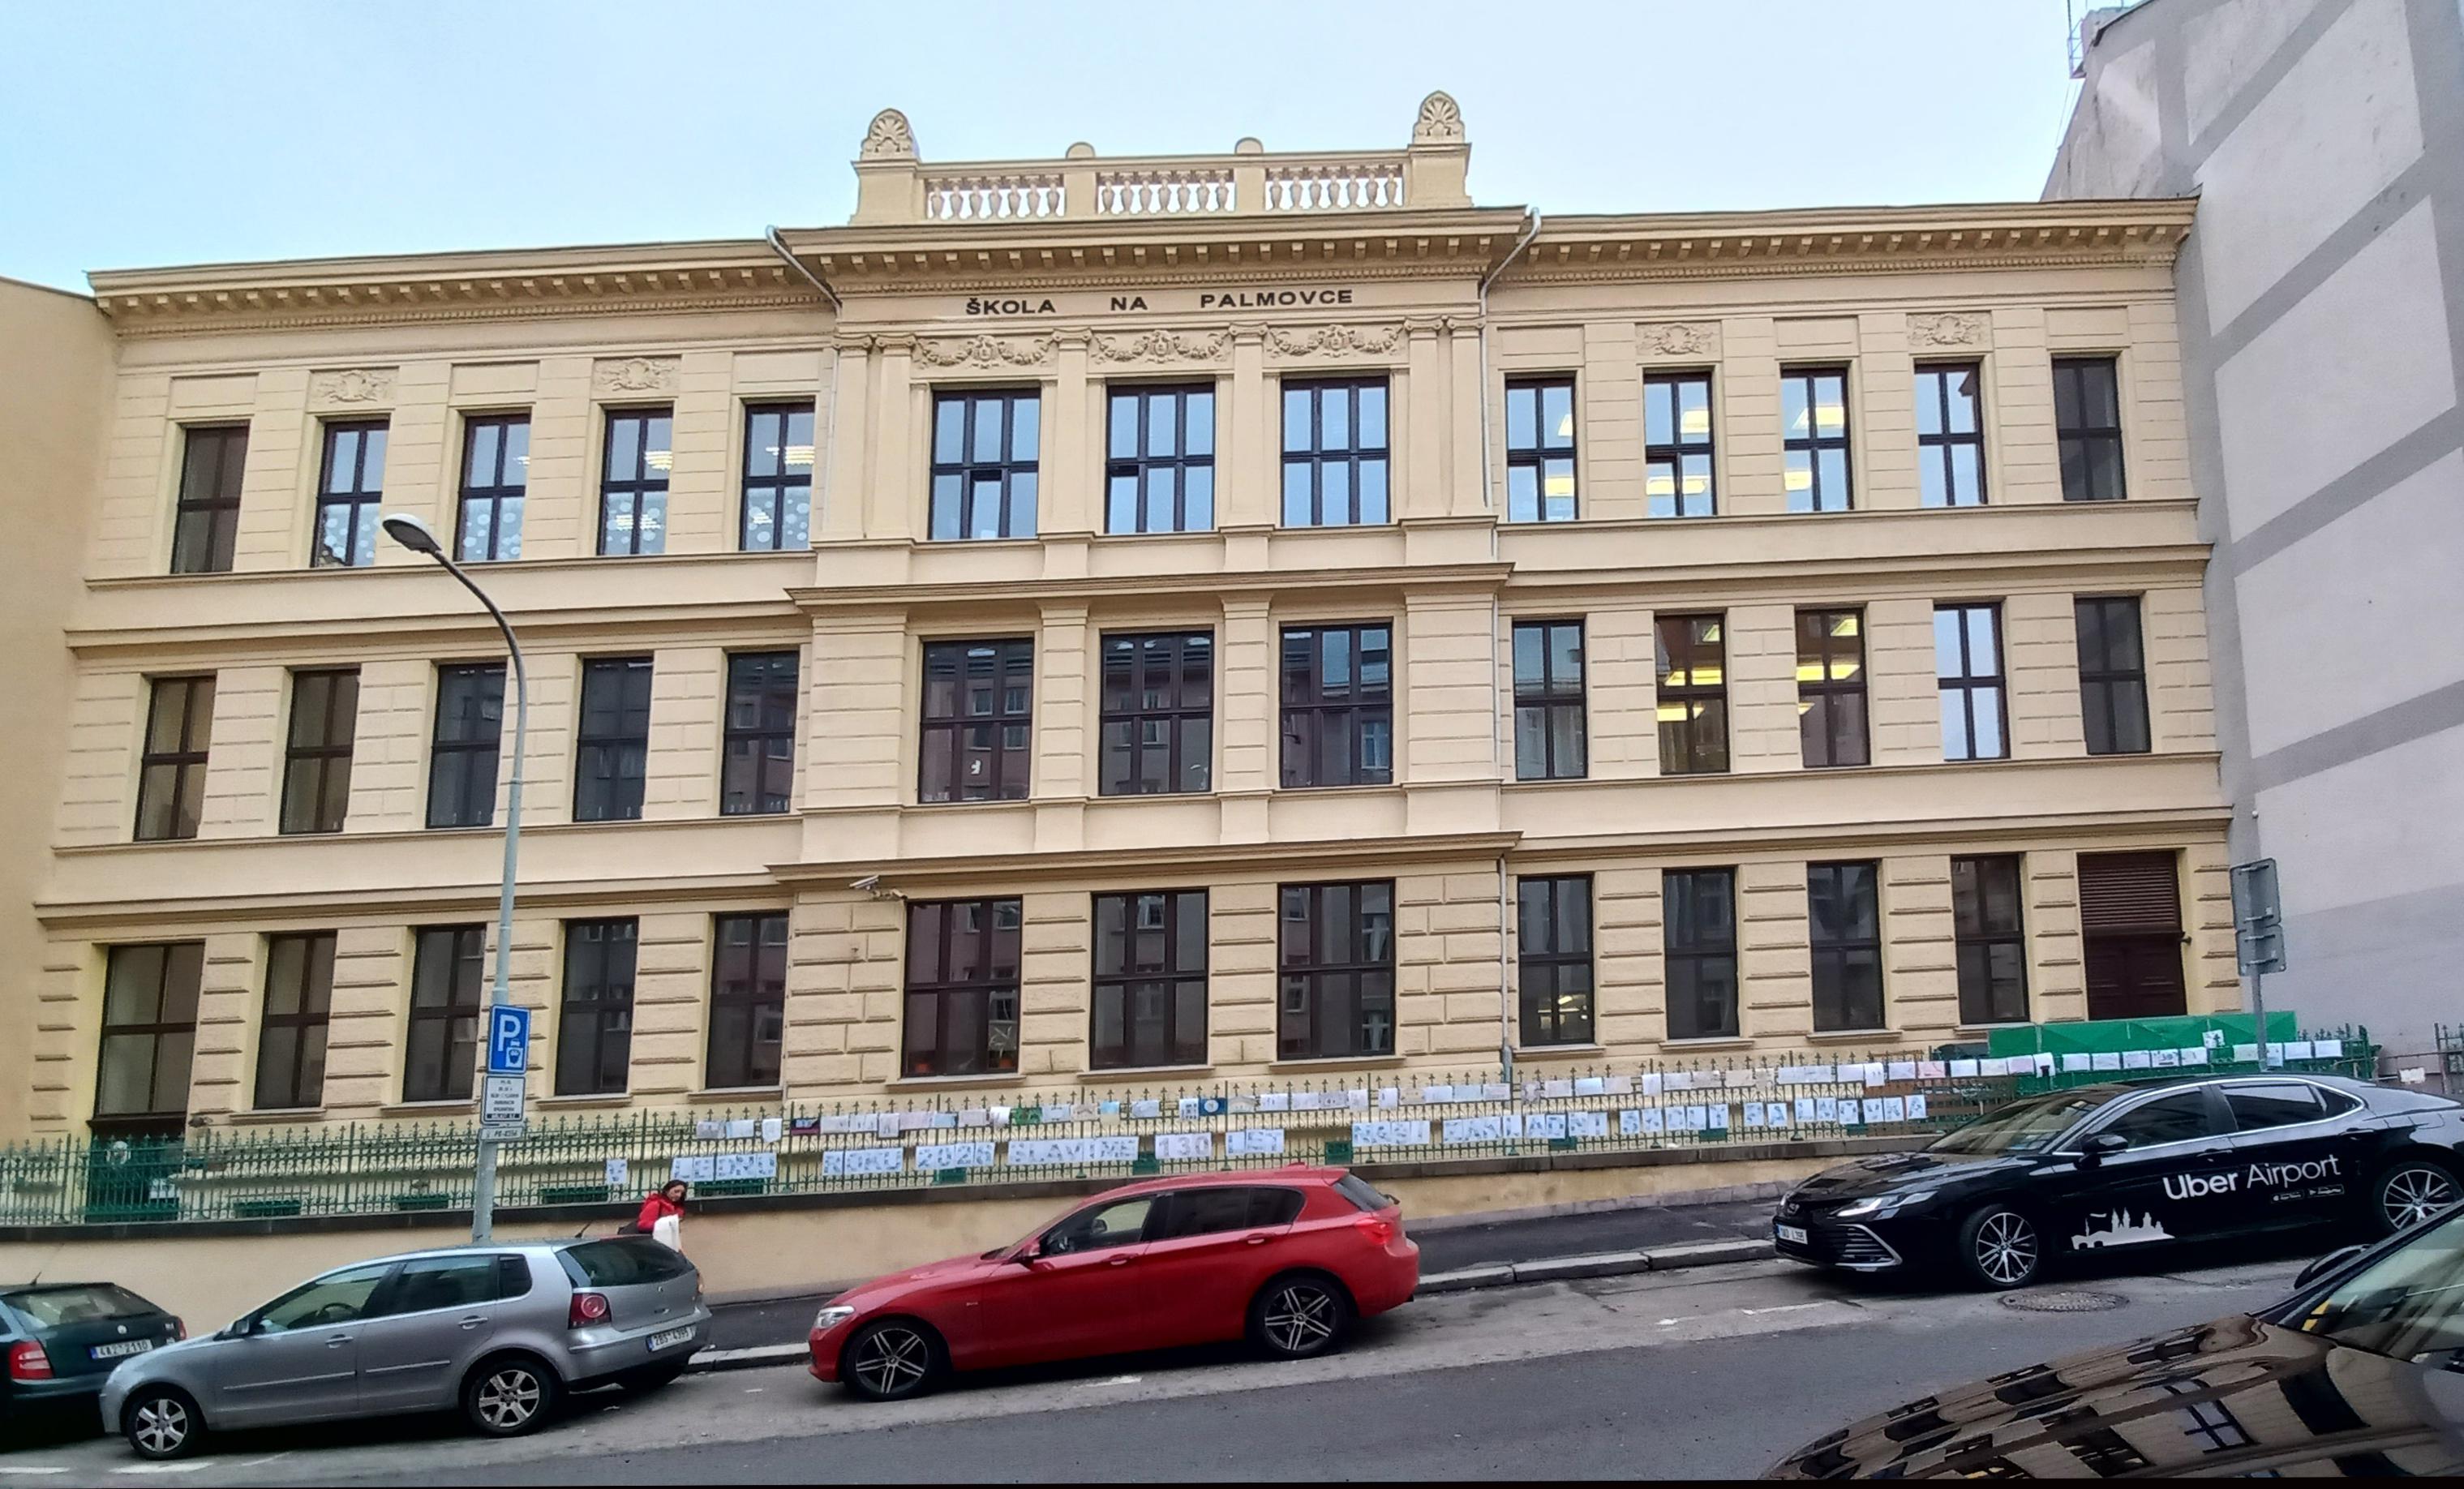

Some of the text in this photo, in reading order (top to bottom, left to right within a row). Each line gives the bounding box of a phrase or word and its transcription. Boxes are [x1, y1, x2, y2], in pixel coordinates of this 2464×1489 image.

[965, 290, 1354, 315] ŠKOLA NA PALMOVCE
[497, 1014, 521, 1052] P
[822, 1150, 902, 1175] ROKU
[917, 1144, 994, 1168] 2026
[1157, 1135, 1210, 1158] 130
[1226, 1131, 1279, 1155] LET
[2163, 1154, 2342, 1199] Uber Airport
